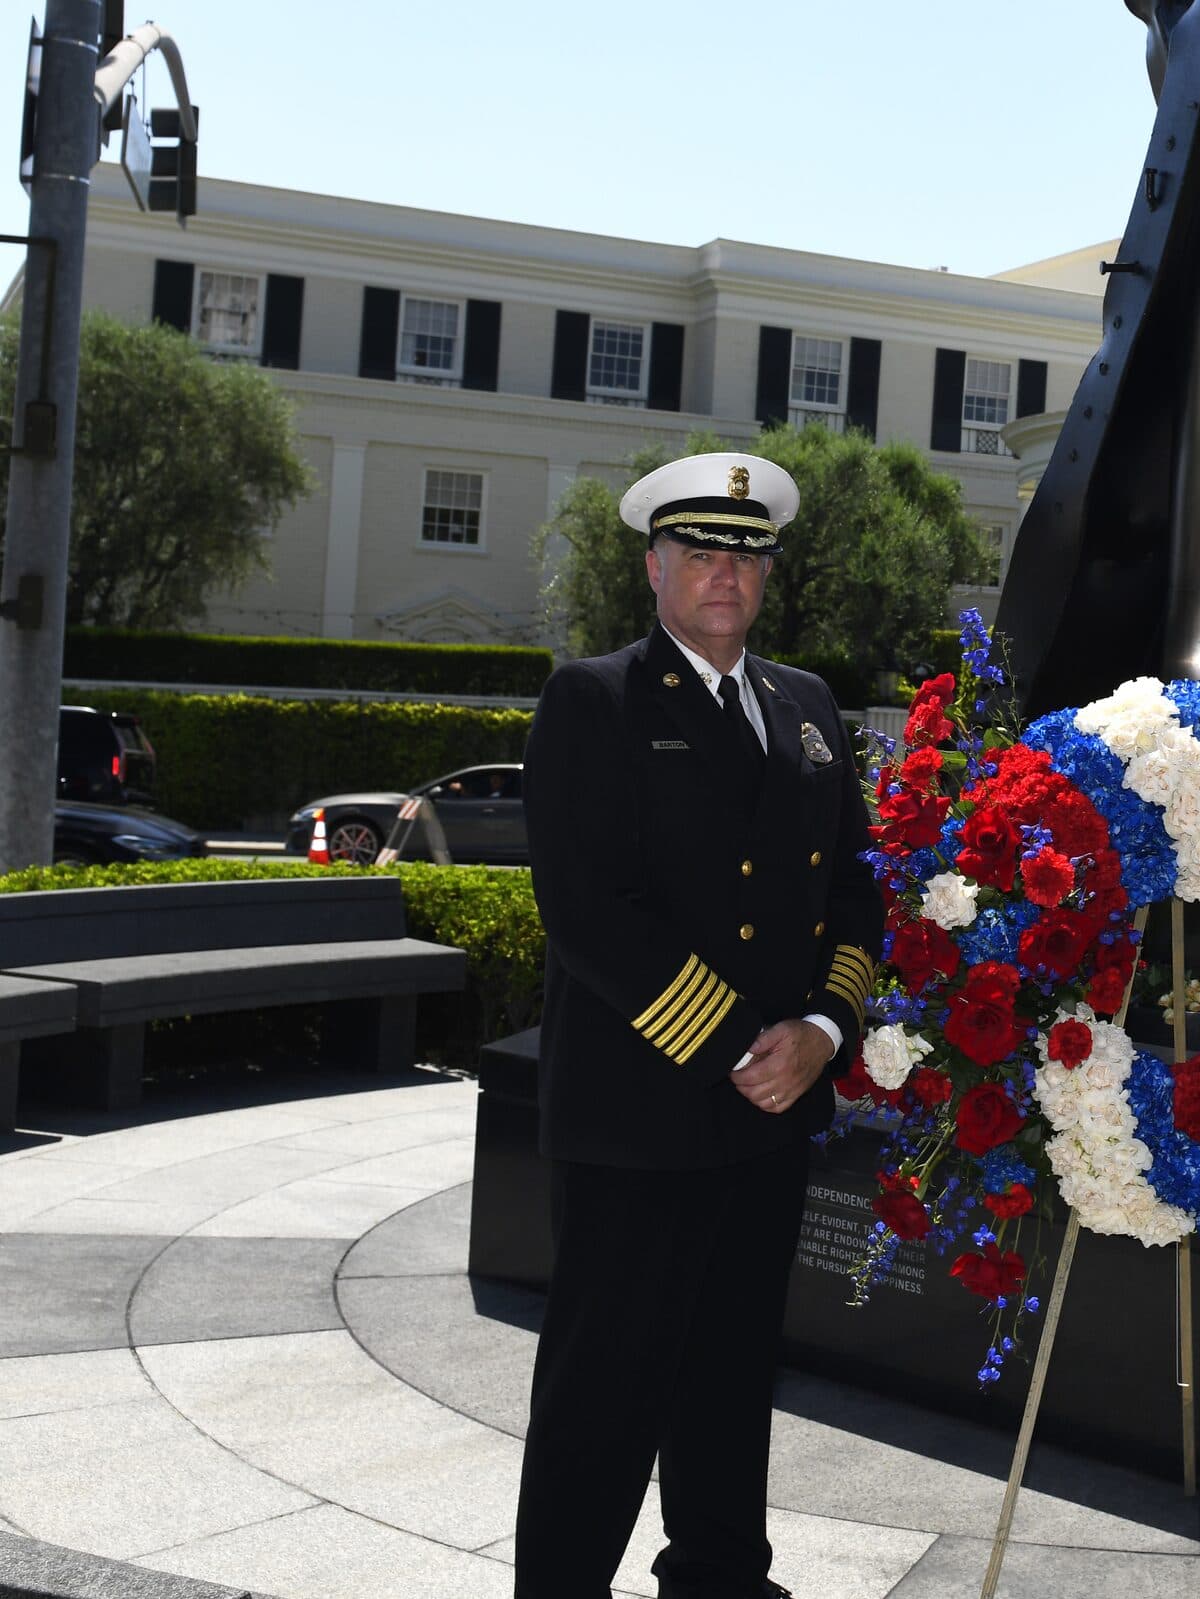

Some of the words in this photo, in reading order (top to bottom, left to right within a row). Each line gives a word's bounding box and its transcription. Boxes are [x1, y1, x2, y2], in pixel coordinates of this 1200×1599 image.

[806, 1185, 873, 1210] NDEPENDENC
[813, 1228, 831, 1241] ARE
[834, 1233, 867, 1249] ENDOW
